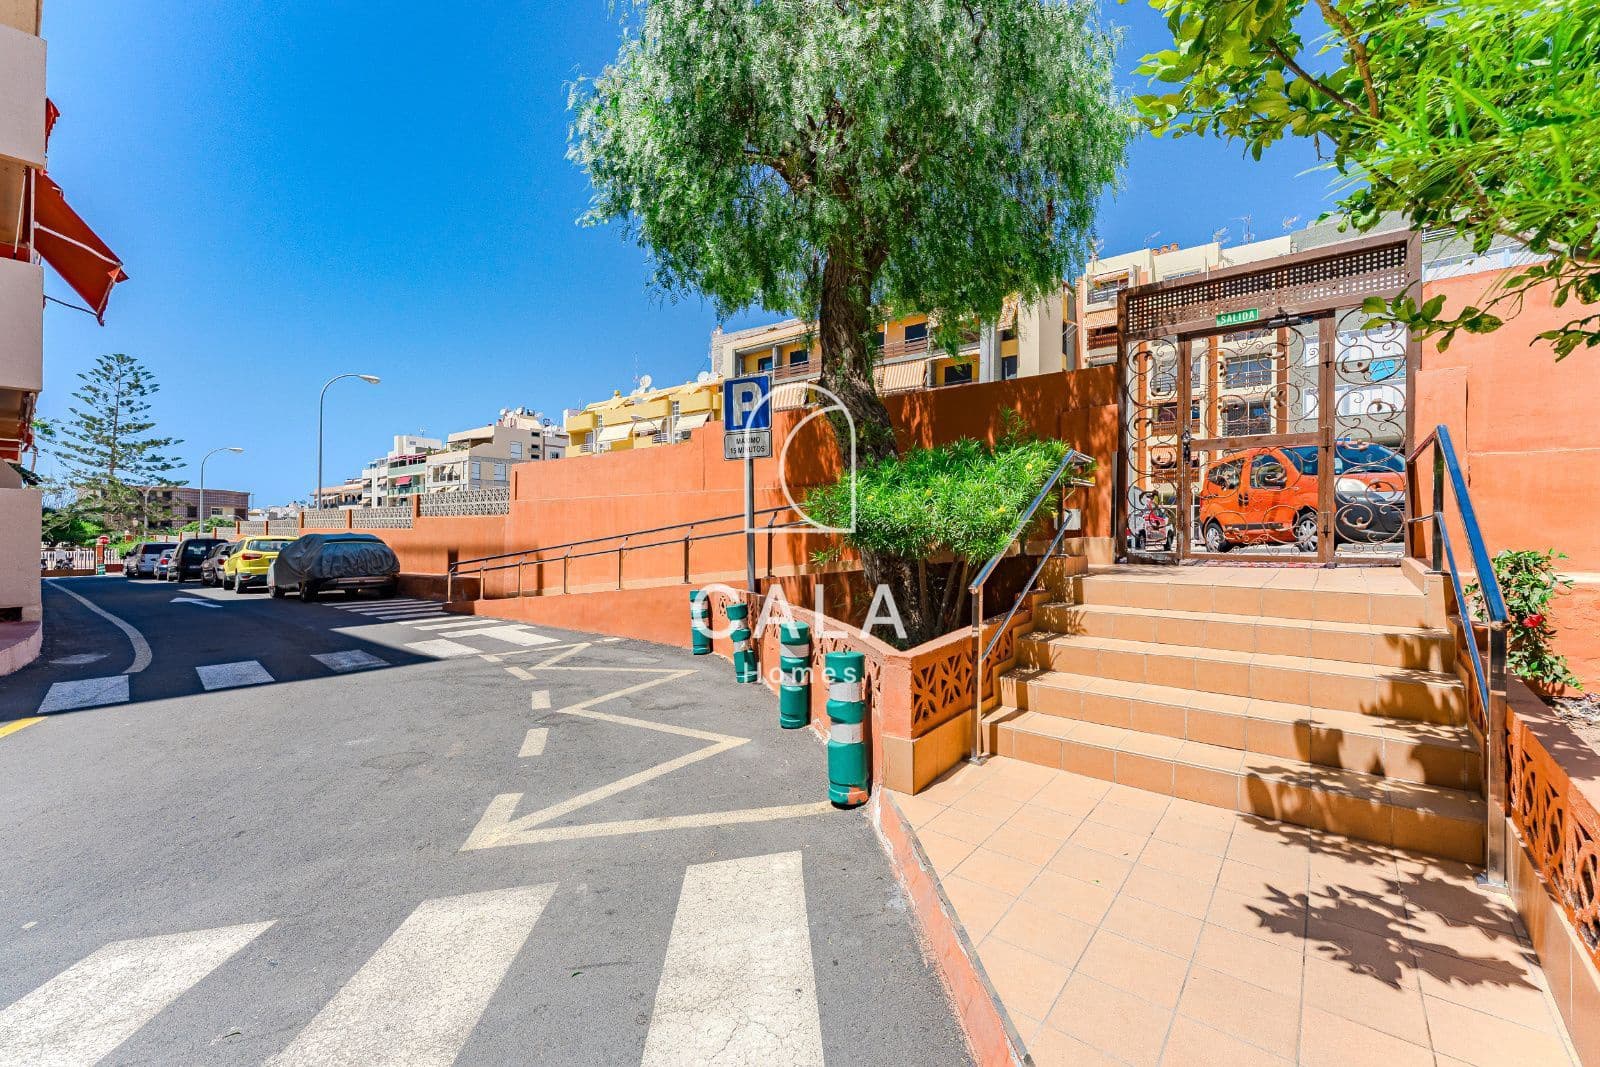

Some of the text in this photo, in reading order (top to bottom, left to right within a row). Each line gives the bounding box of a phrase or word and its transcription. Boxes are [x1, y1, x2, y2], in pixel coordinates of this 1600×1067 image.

[1220, 311, 1255, 324] SALIDA
[733, 382, 762, 426] P
[738, 445, 765, 454] MIUTOS
